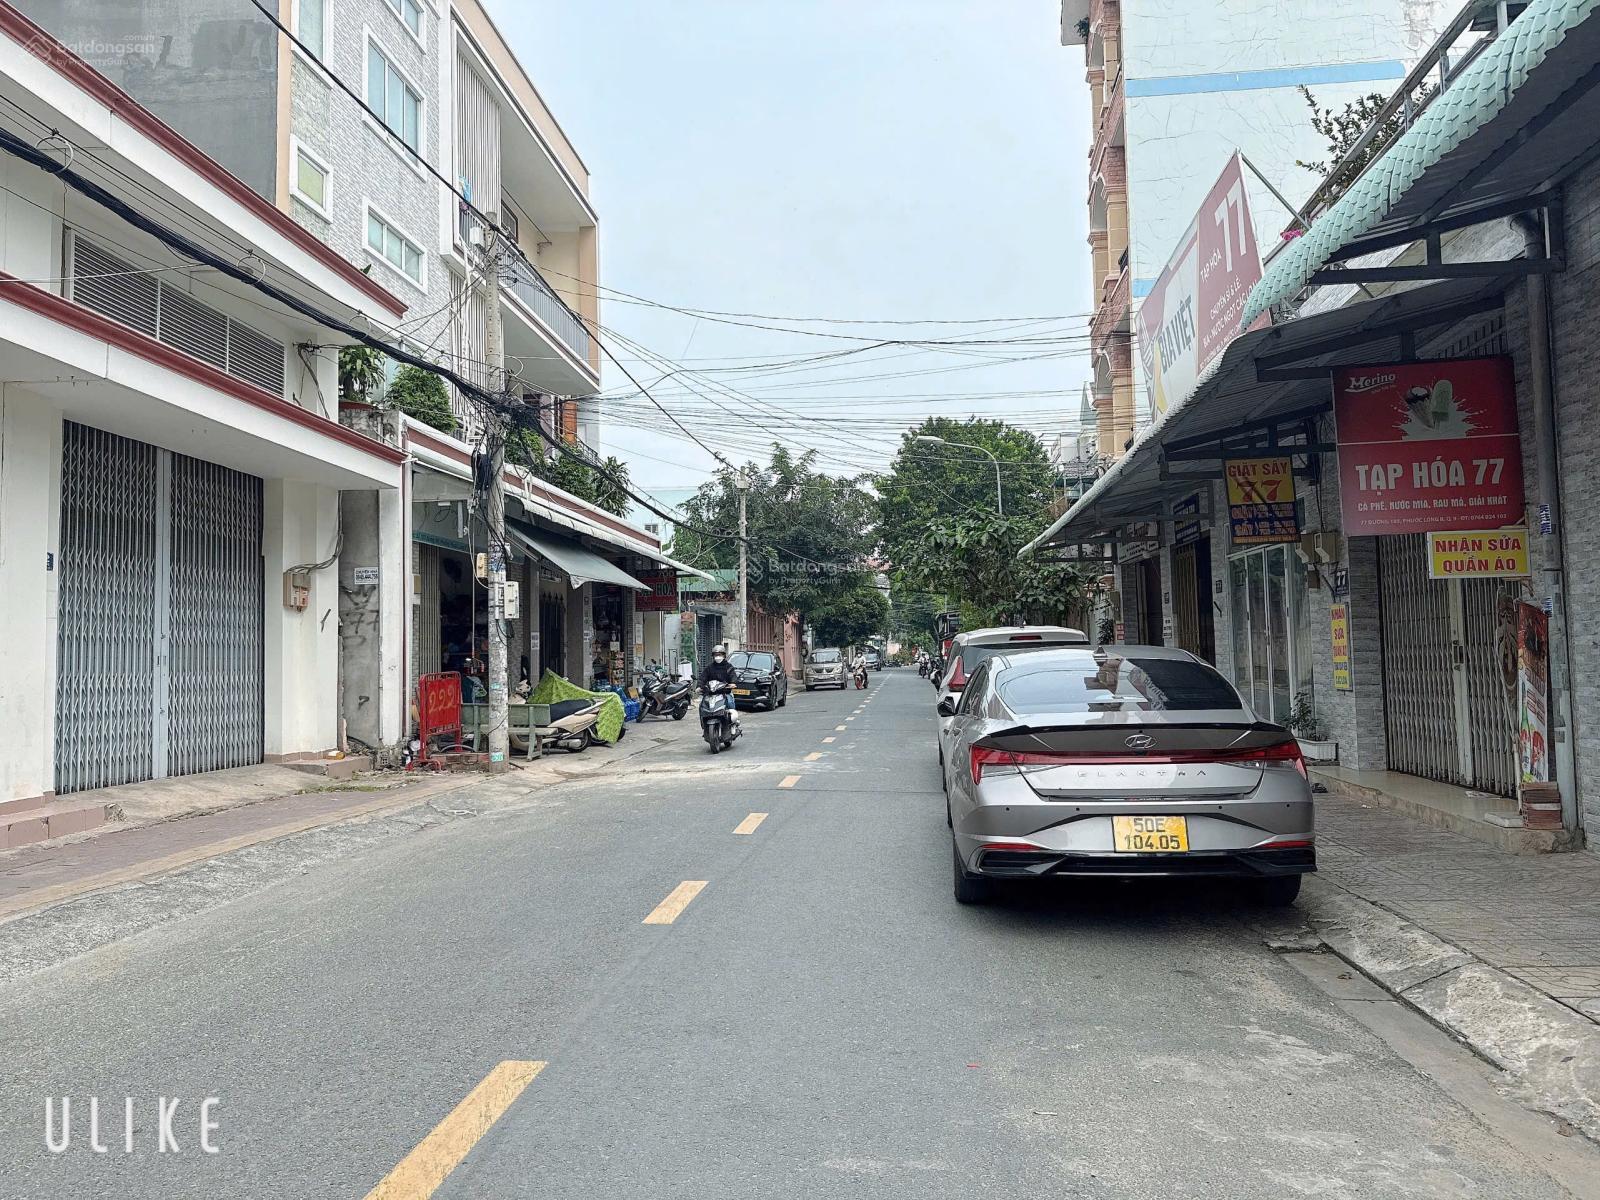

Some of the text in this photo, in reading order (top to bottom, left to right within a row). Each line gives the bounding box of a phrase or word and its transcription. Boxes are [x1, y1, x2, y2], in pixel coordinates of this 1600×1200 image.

[1215, 177, 1246, 272] 77
[1200, 247, 1222, 284] TẠP HÓA
[1223, 303, 1237, 326] NGỌT
[1158, 294, 1196, 374] BIA VIỆT
[1350, 373, 1396, 389] Merino
[1355, 456, 1505, 496] TẠP HÓA 77
[1237, 480, 1282, 502] 77
[1433, 498, 1449, 508] RAU
[1435, 534, 1521, 554] NHẬN SỬA
[1443, 555, 1516, 573] QUẦN ÁO
[1336, 571, 1347, 585] 77
[429, 685, 457, 714] 222
[1133, 817, 1166, 833] 50E
[1124, 835, 1180, 850] 104.05
